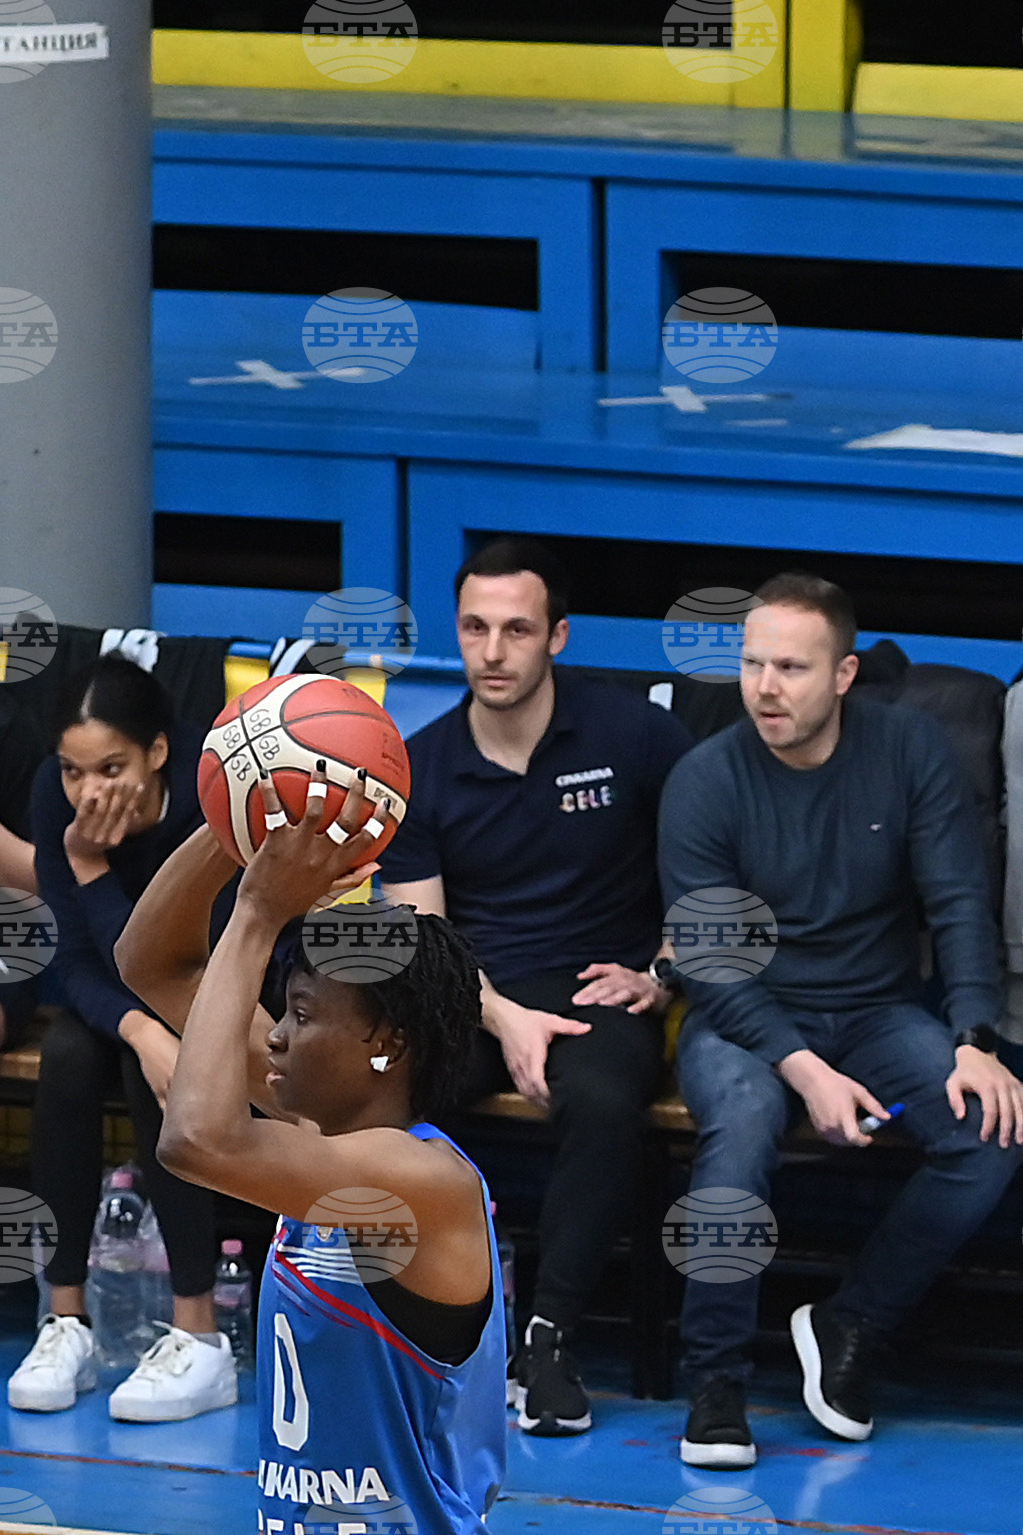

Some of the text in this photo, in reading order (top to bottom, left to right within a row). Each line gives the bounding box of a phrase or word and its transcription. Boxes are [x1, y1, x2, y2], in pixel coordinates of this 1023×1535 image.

[249, 709, 272, 733] GB
[222, 724, 242, 750] GB
[259, 735, 281, 761] GB
[231, 754, 253, 781] GB
[272, 1312, 309, 1451] 0
